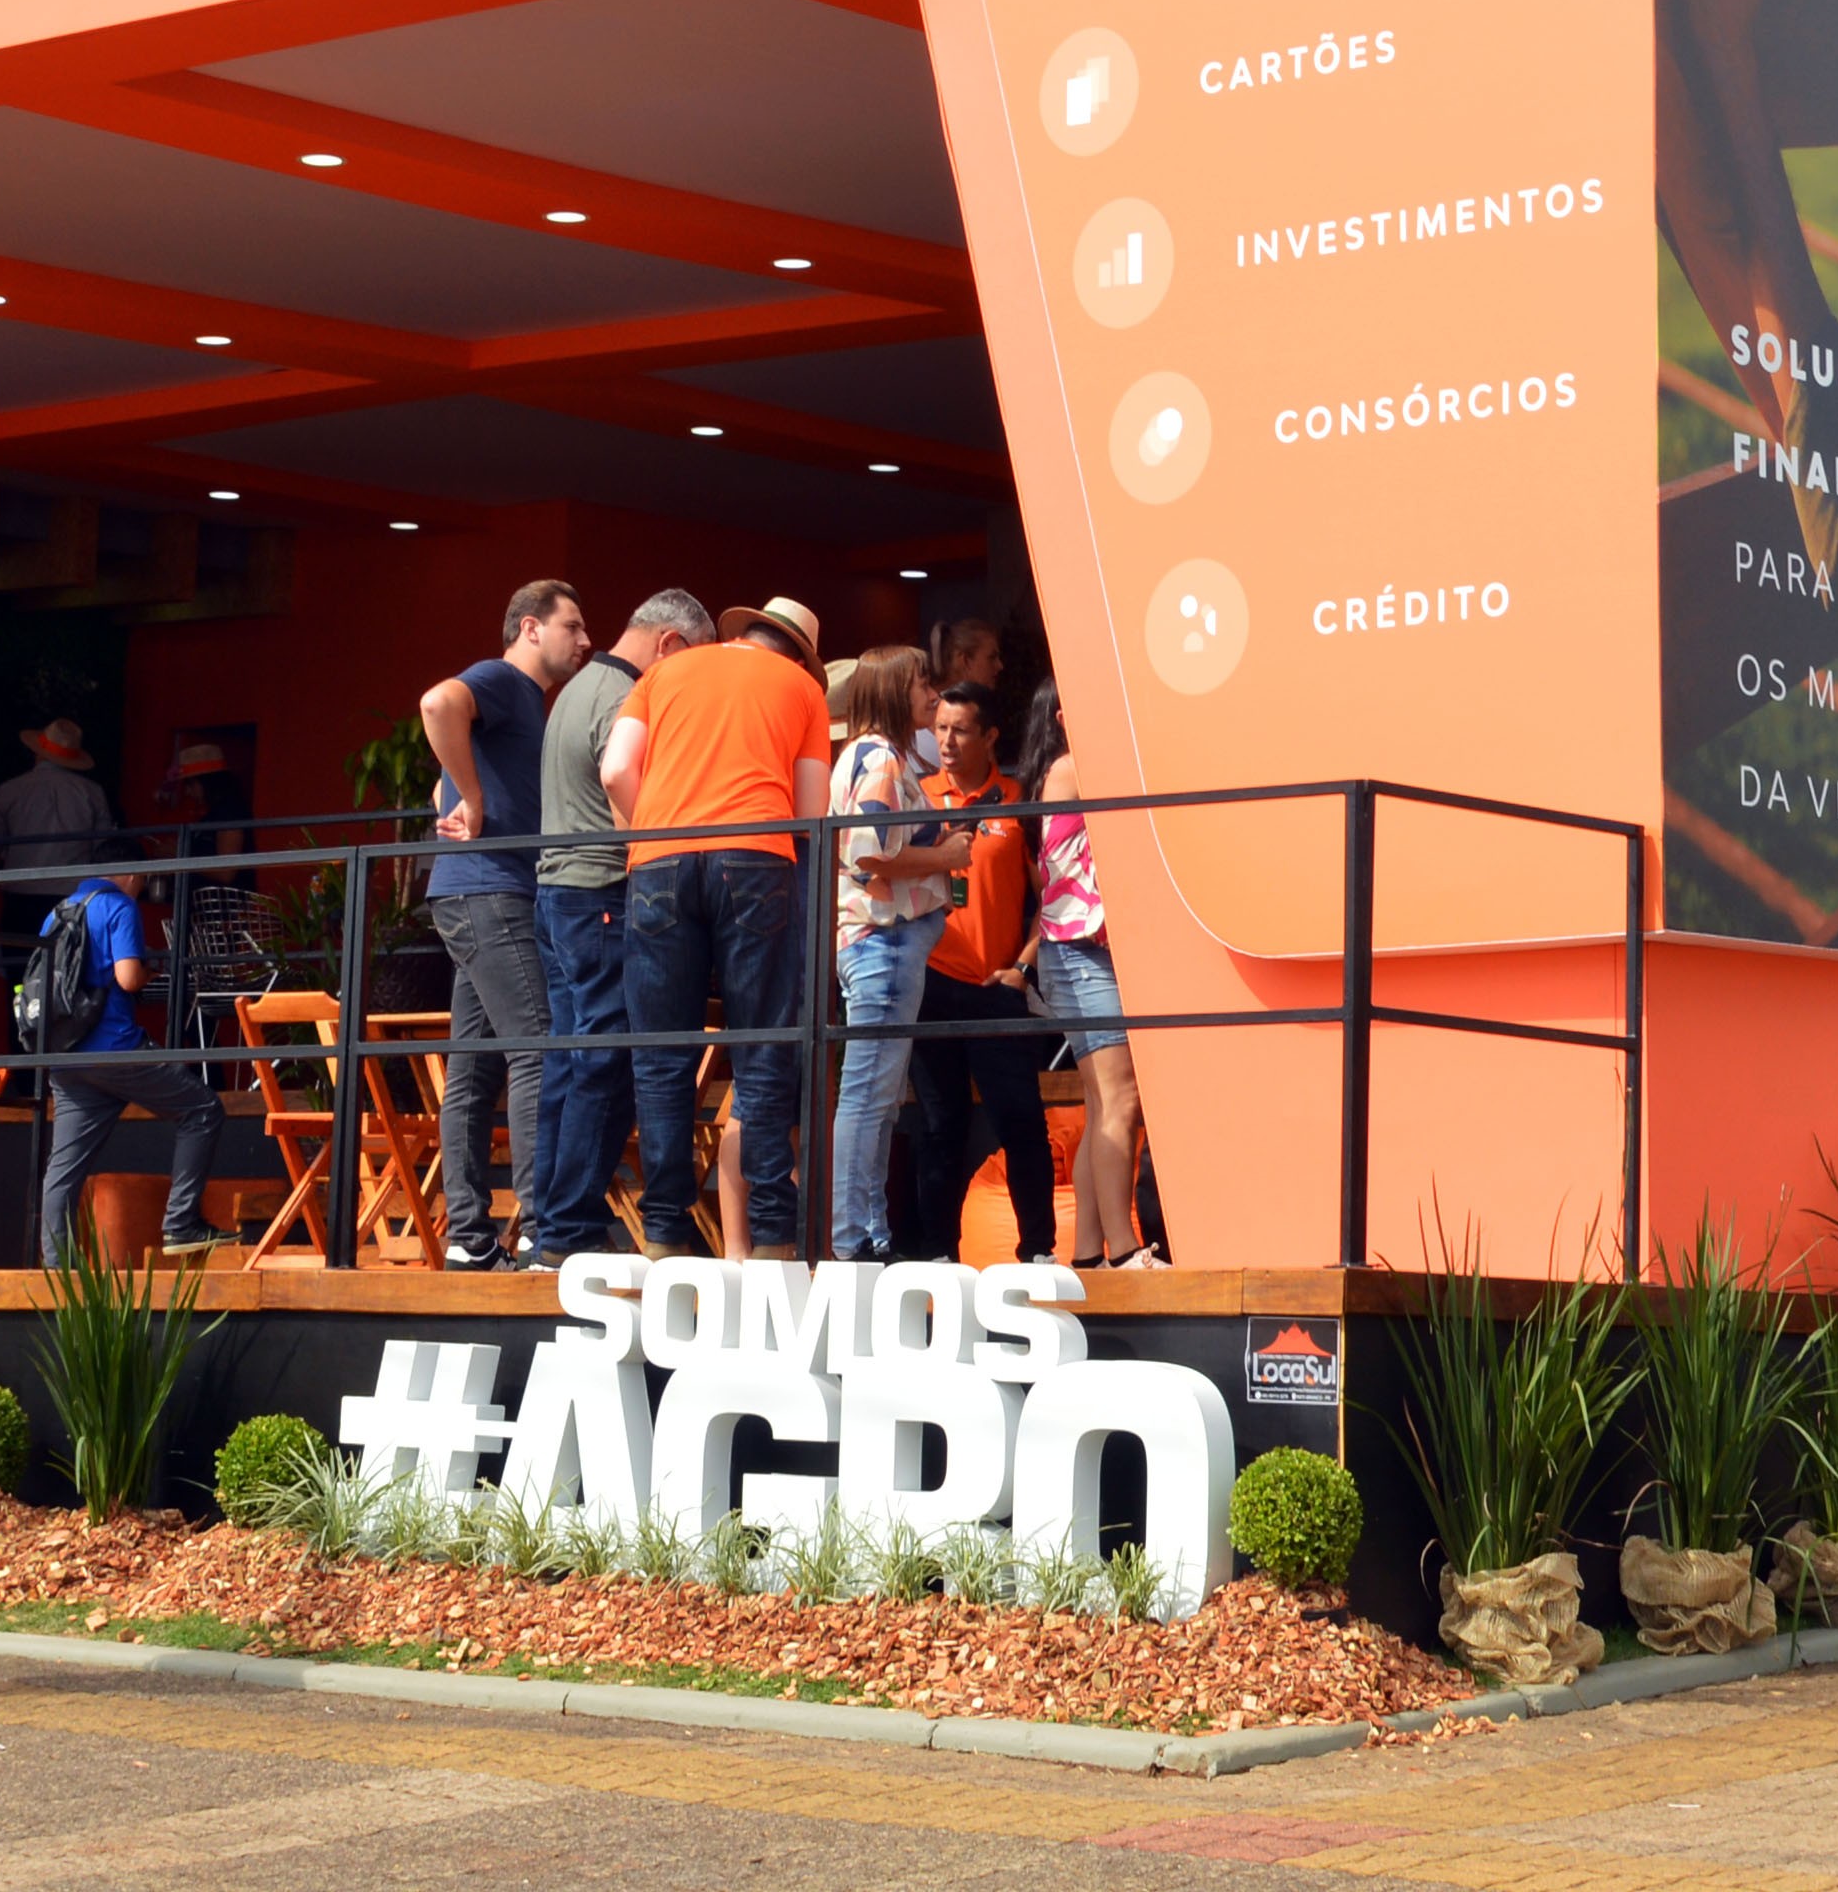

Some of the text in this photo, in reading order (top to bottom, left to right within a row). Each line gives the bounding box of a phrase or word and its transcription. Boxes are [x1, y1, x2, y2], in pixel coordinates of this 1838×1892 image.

[1199, 31, 1396, 94] CARTÕES
[1236, 178, 1603, 266] INVESTIMENTOS
[1275, 373, 1577, 443] CONSÓRCIOS
[1735, 541, 1834, 602] PARA
[1313, 582, 1509, 634] CRÉDITO
[1737, 654, 1786, 700] OS
[1740, 764, 1790, 812] DA
[558, 1253, 1087, 1381] SOMOS
[1253, 1353, 1336, 1386] LocaSul
